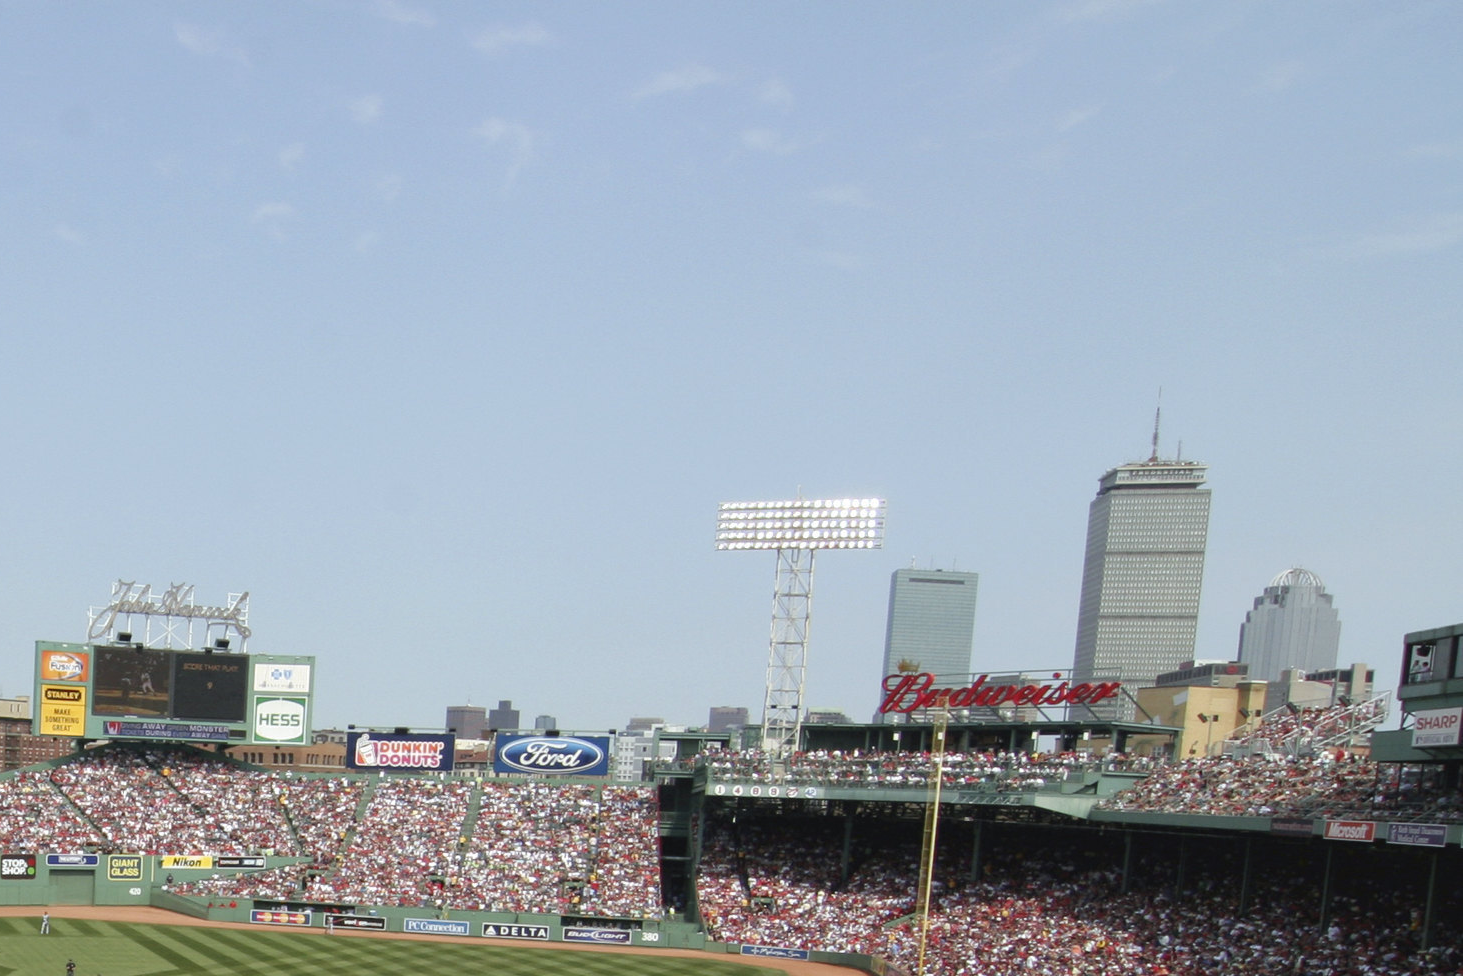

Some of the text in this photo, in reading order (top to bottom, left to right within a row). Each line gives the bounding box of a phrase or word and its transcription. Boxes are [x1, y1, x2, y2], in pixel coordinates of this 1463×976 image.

[89, 579, 252, 639] John Hancock
[47, 690, 79, 699] STANLEY
[880, 672, 1122, 713] Budweiser
[45, 716, 79, 724] SOMETHING
[259, 713, 299, 726] HESS
[1417, 715, 1457, 730] SHARP
[379, 742, 444, 753] DUNKIN'
[520, 742, 583, 767] Ford
[379, 755, 439, 766] DONUTS
[1327, 823, 1367, 839] Microsoft
[112, 859, 139, 867] GIANT
[172, 858, 201, 867] Nikon
[111, 868, 139, 876] GLASS
[408, 921, 465, 933] PC Connection
[500, 927, 546, 937] DELTA
[641, 932, 659, 941] 380
